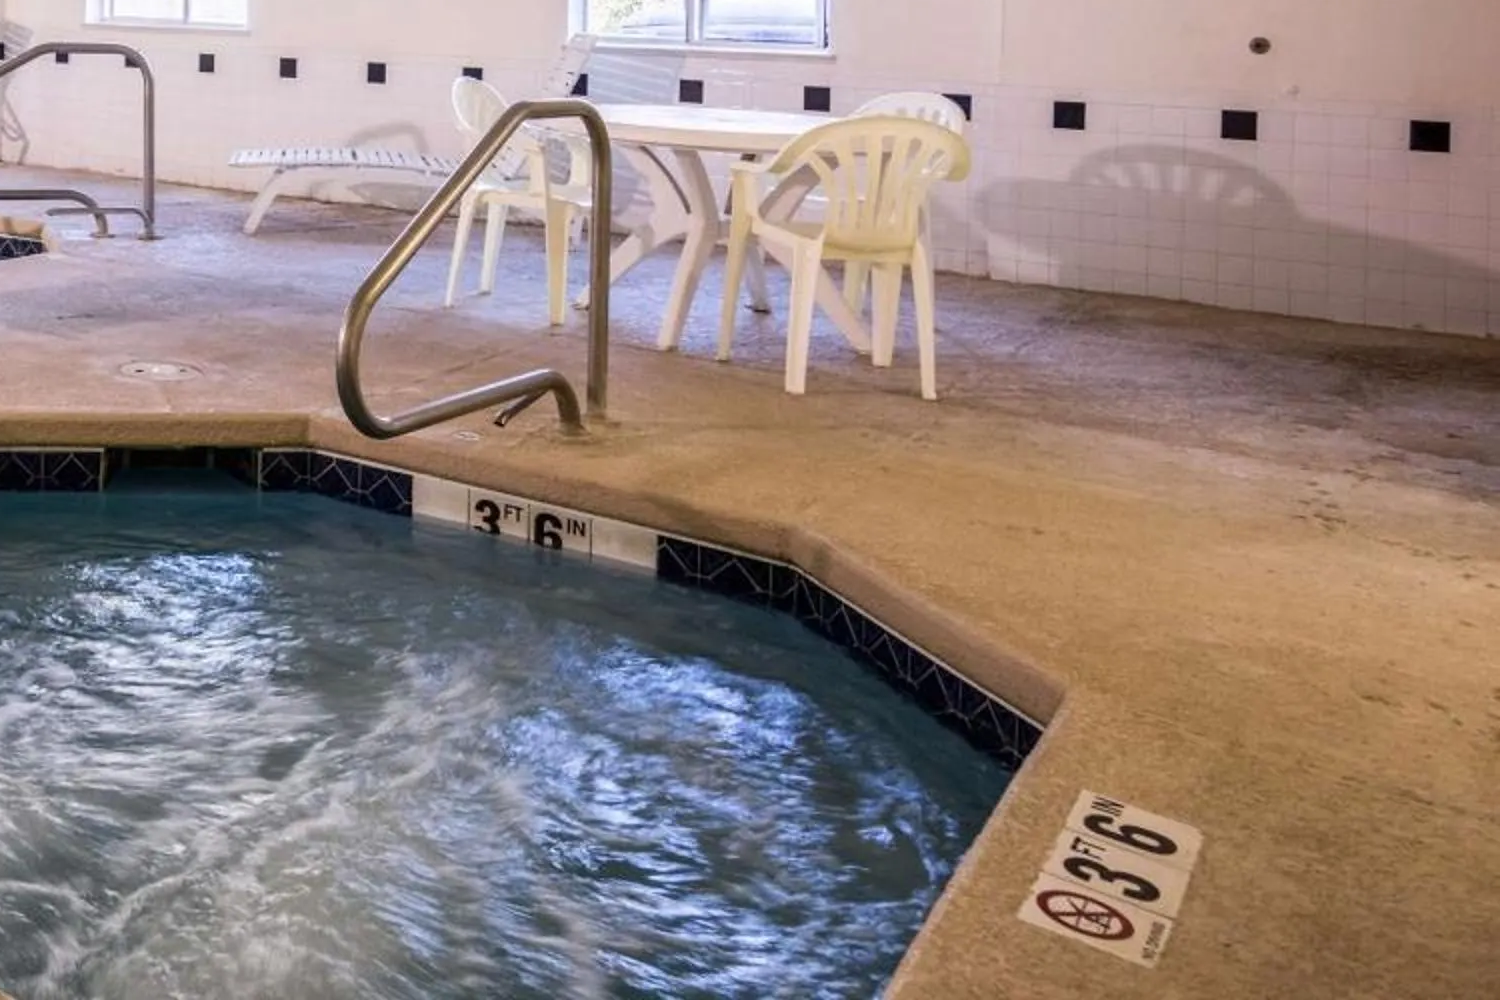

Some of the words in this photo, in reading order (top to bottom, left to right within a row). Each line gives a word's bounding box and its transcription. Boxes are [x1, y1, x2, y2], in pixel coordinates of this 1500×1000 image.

[474, 499, 500, 535] 3
[503, 505, 523, 522] FT
[533, 513, 562, 549] 6
[566, 518, 586, 537] IN
[1084, 813, 1177, 855] 6
[1063, 857, 1160, 902] 3
